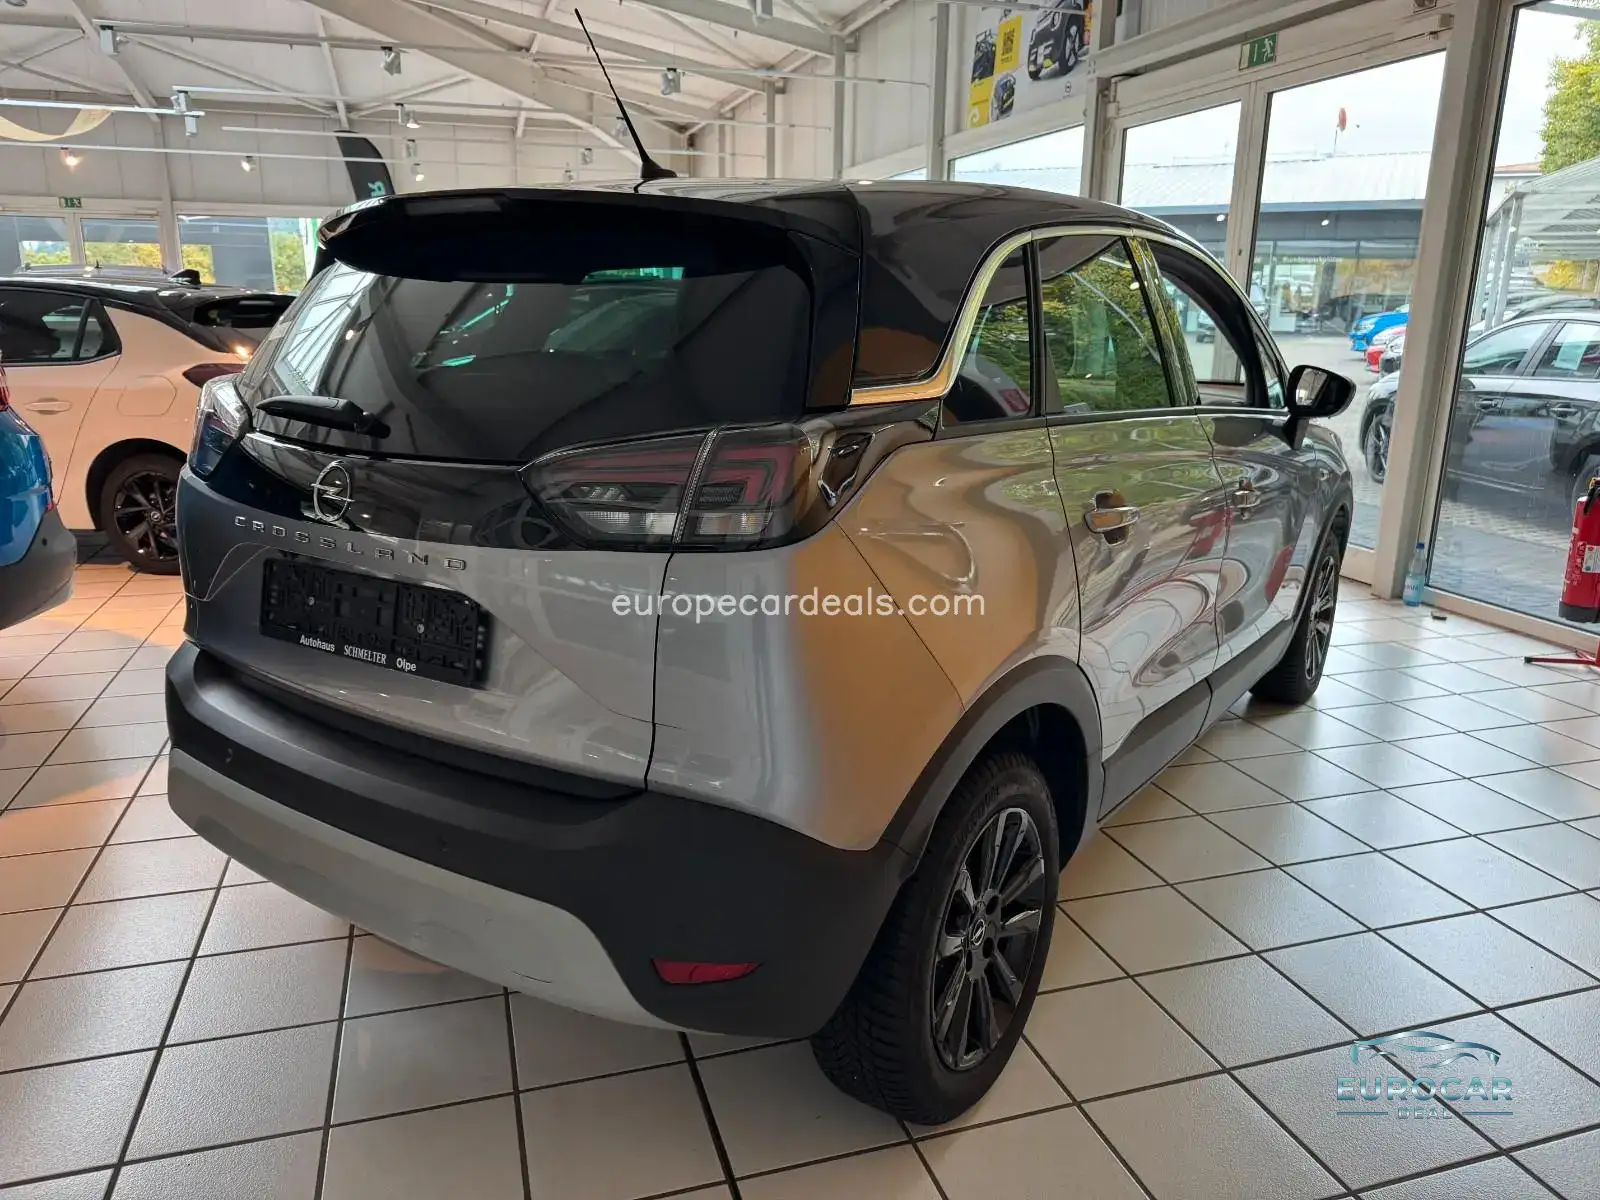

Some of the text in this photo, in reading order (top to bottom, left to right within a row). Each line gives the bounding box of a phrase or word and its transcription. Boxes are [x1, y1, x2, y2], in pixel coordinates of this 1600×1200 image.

[234, 516, 466, 571] CROSSLAND
[299, 634, 417, 672] Autohaus SCHMELTER Olpe
